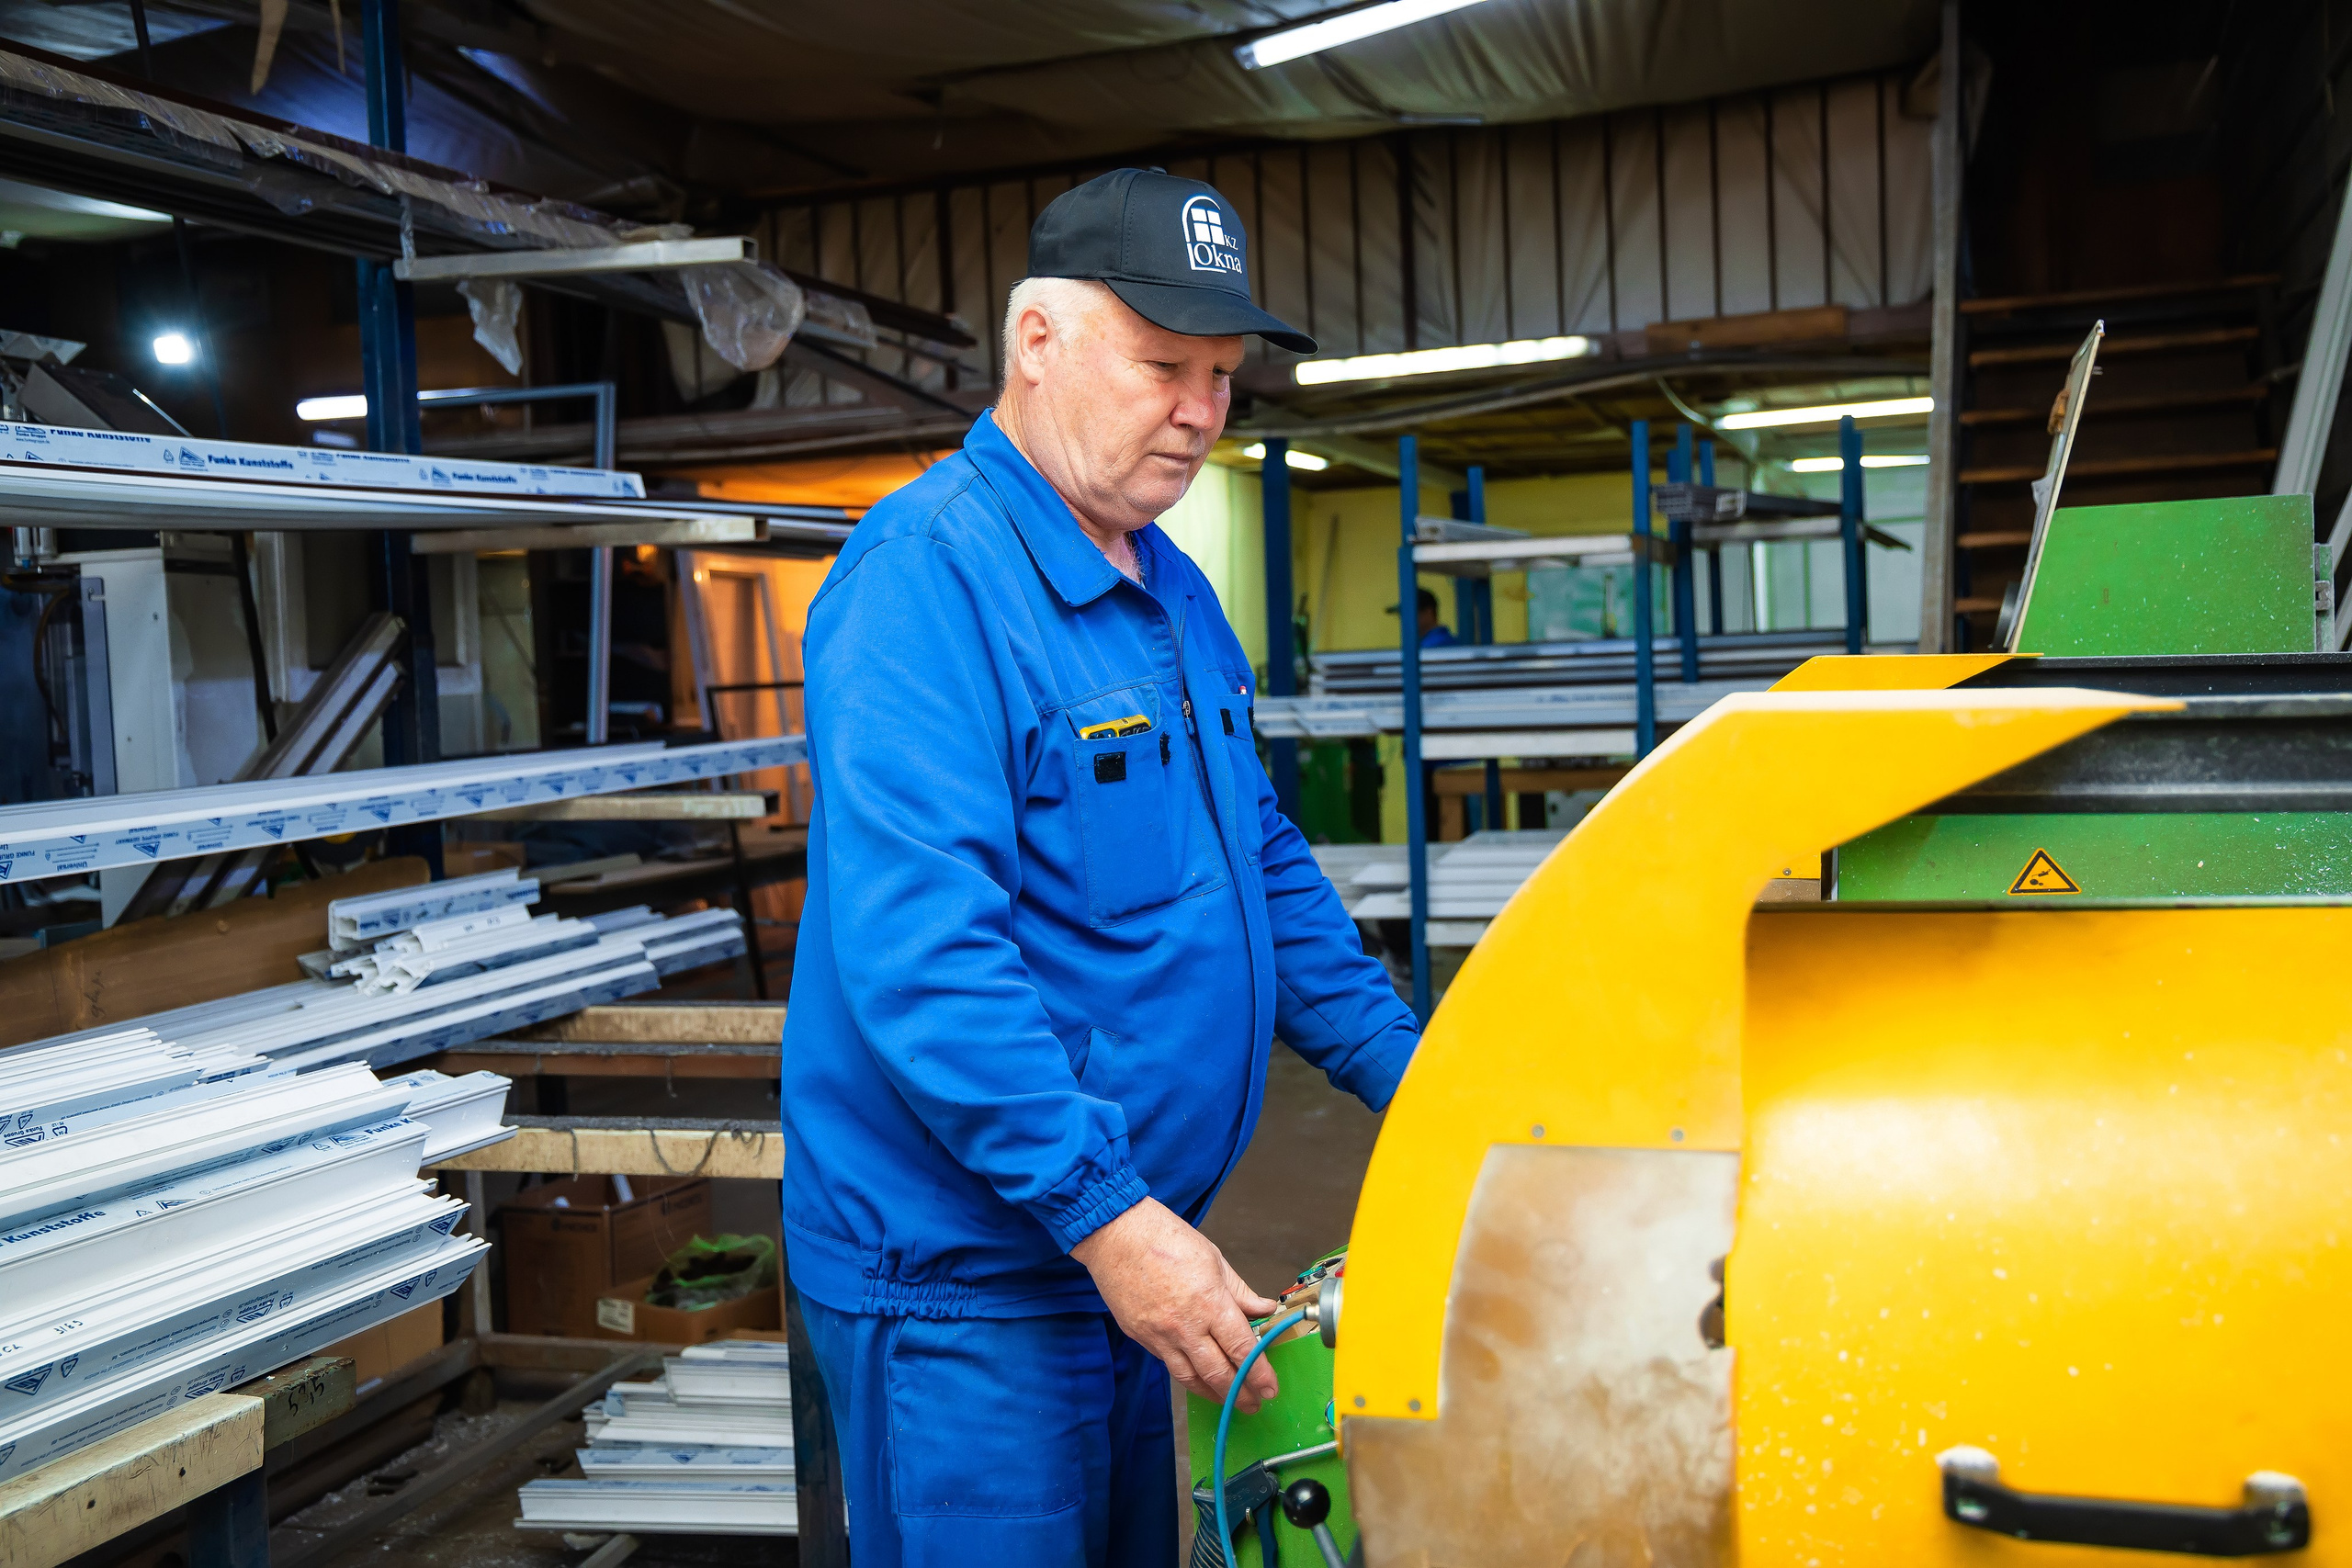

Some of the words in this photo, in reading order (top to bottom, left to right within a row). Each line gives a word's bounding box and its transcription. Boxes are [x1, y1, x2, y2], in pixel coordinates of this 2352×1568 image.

[1194, 243, 1242, 274] Okna
[208, 454, 237, 466] Funke
[57, 861, 87, 872] Universal
[364, 1122, 402, 1134] Funke
[2, 1211, 107, 1243] Kunststoffe
